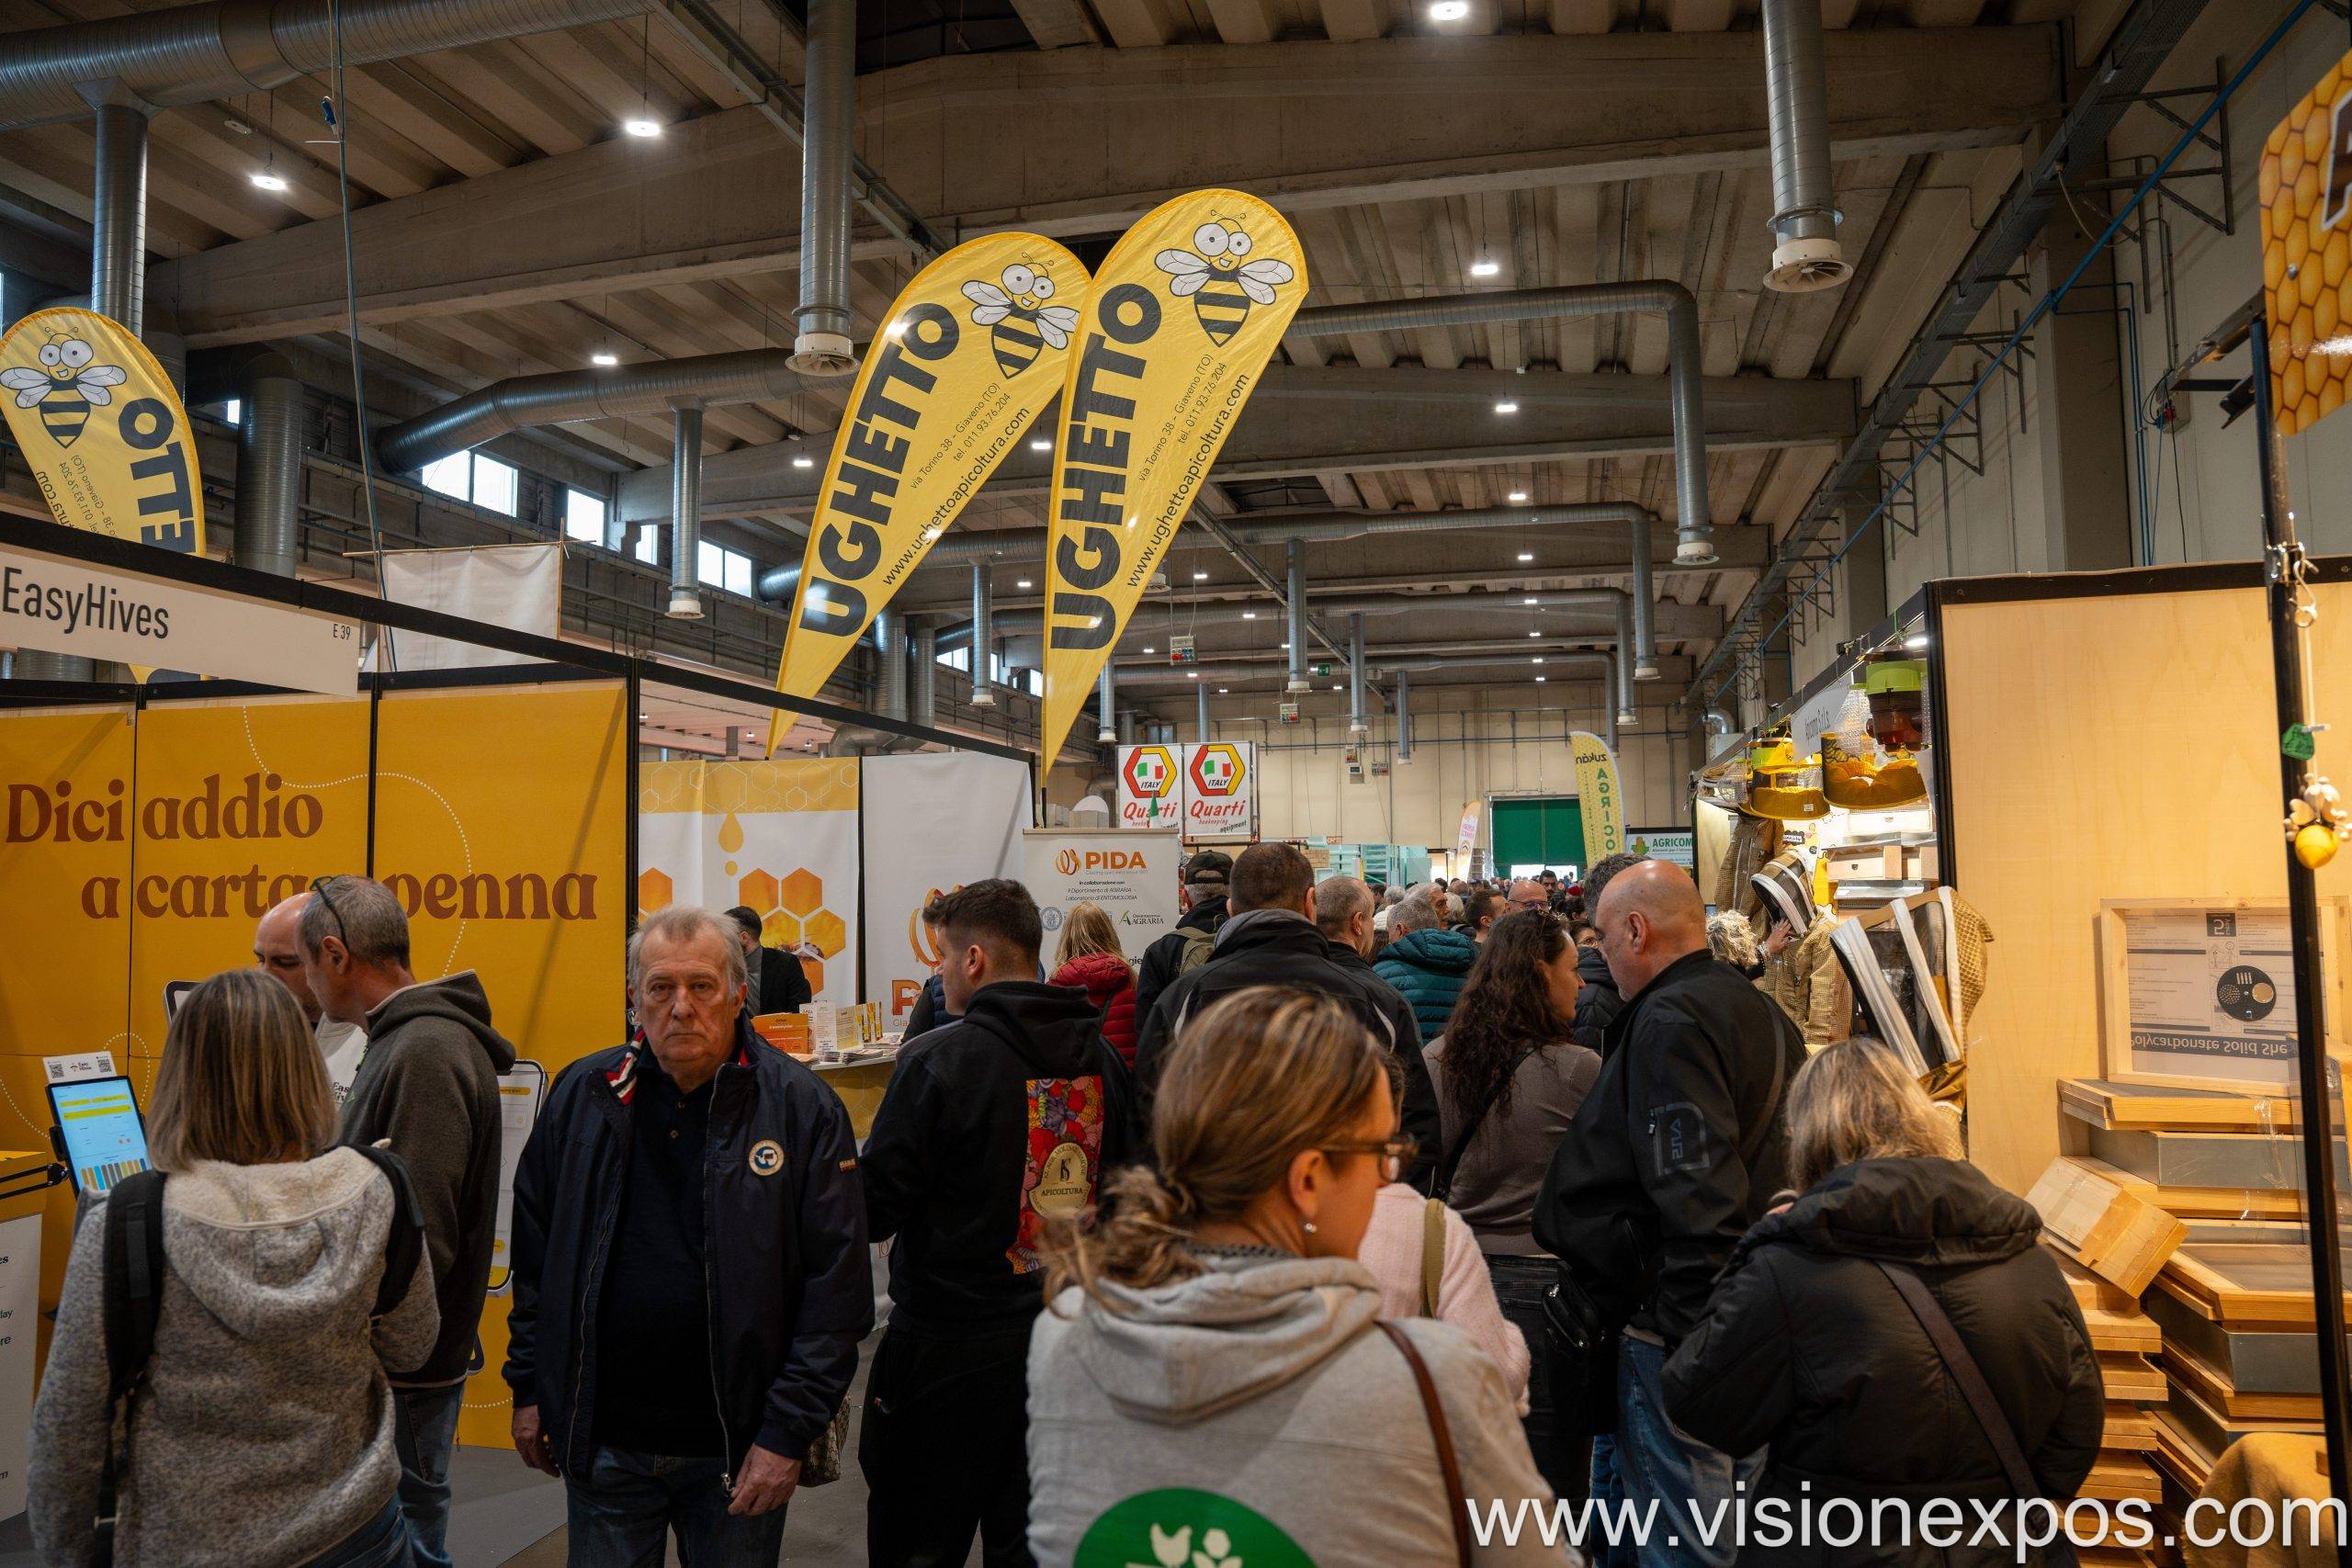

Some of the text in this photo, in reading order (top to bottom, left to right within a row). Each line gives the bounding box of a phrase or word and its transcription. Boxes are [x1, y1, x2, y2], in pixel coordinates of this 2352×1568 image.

[910, 476, 923, 490] via
[919, 451, 944, 477] Torino
[940, 438, 953, 452] 38
[956, 402, 986, 434] Giaveno
[982, 382, 1001, 403] (TO)
[953, 392, 1012, 462] tel. 011.93.76.204
[1139, 467, 1150, 482] via
[1145, 437, 1167, 466] Torino
[1161, 422, 1175, 436] 38
[1174, 376, 1201, 414] Giaveno
[1196, 354, 1215, 376] (TO)
[1177, 362, 1227, 445] tel. 011.93.76.204
[798, 302, 959, 637] UGHETTO
[882, 407, 1030, 586] www.ughettoapicoltura.com
[1050, 284, 1161, 650] UGHETTO
[1126, 373, 1250, 588] www.ughettoapicoltura.com
[2, 566, 169, 640] EasyHives
[333, 623, 351, 641] E 39
[6, 772, 323, 843] Dici addio
[1140, 781, 1161, 789] ITALY
[1190, 800, 1247, 818] Quarti
[81, 875, 121, 919] a
[1085, 852, 1147, 870] PIDA
[1041, 1187, 1083, 1196] APICOLTURA
